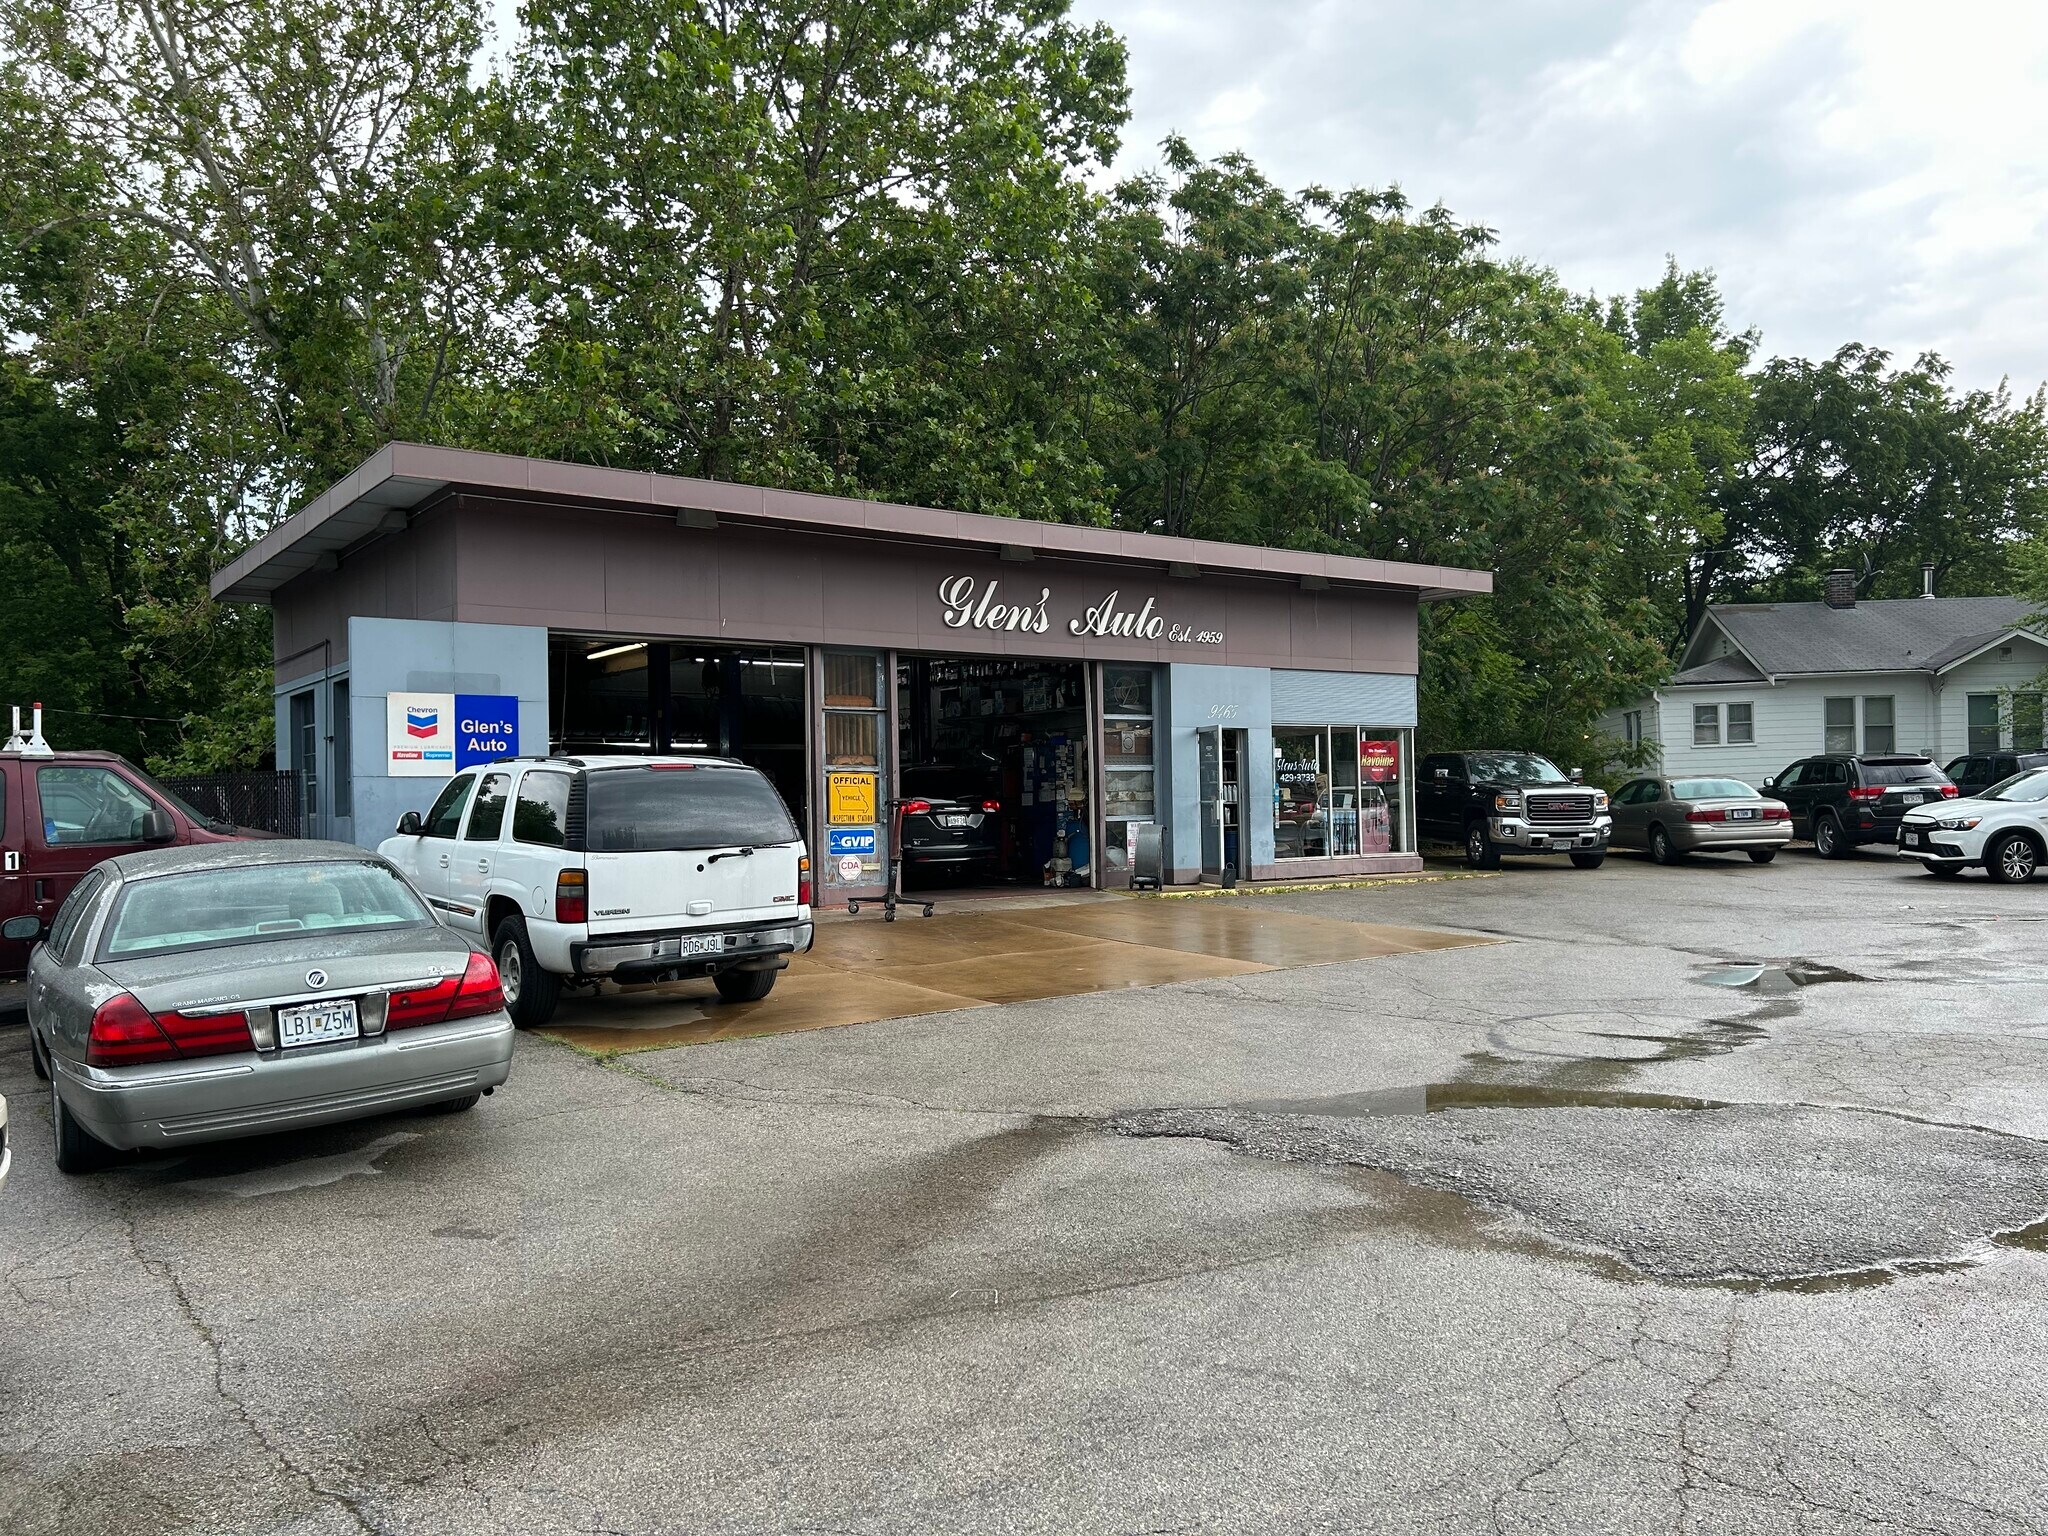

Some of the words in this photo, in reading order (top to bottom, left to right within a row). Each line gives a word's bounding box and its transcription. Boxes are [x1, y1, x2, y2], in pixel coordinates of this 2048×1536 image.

[938, 575, 1050, 634] Glen's
[1069, 589, 1164, 640] Auto
[1168, 623, 1192, 643] Est.
[1195, 630, 1224, 644] 1959
[407, 706, 438, 714] Chevron
[1207, 704, 1239, 719] 9465
[461, 719, 513, 734] Glen's
[467, 737, 508, 752] Auto
[1360, 754, 1395, 767] Havoline
[833, 776, 872, 785] OFFICIAL
[832, 814, 855, 822] INSPECTION
[857, 814, 873, 822] STATION
[841, 836, 874, 847] GVIP
[8, 853, 16, 869] 1
[840, 861, 860, 870] CDA
[594, 908, 631, 916] YUKON
[682, 940, 700, 954] RD6
[704, 938, 721, 952] J9L
[197, 995, 228, 1005] MARQUIS
[284, 1014, 313, 1038] LB1
[323, 1008, 353, 1032] Z5M
